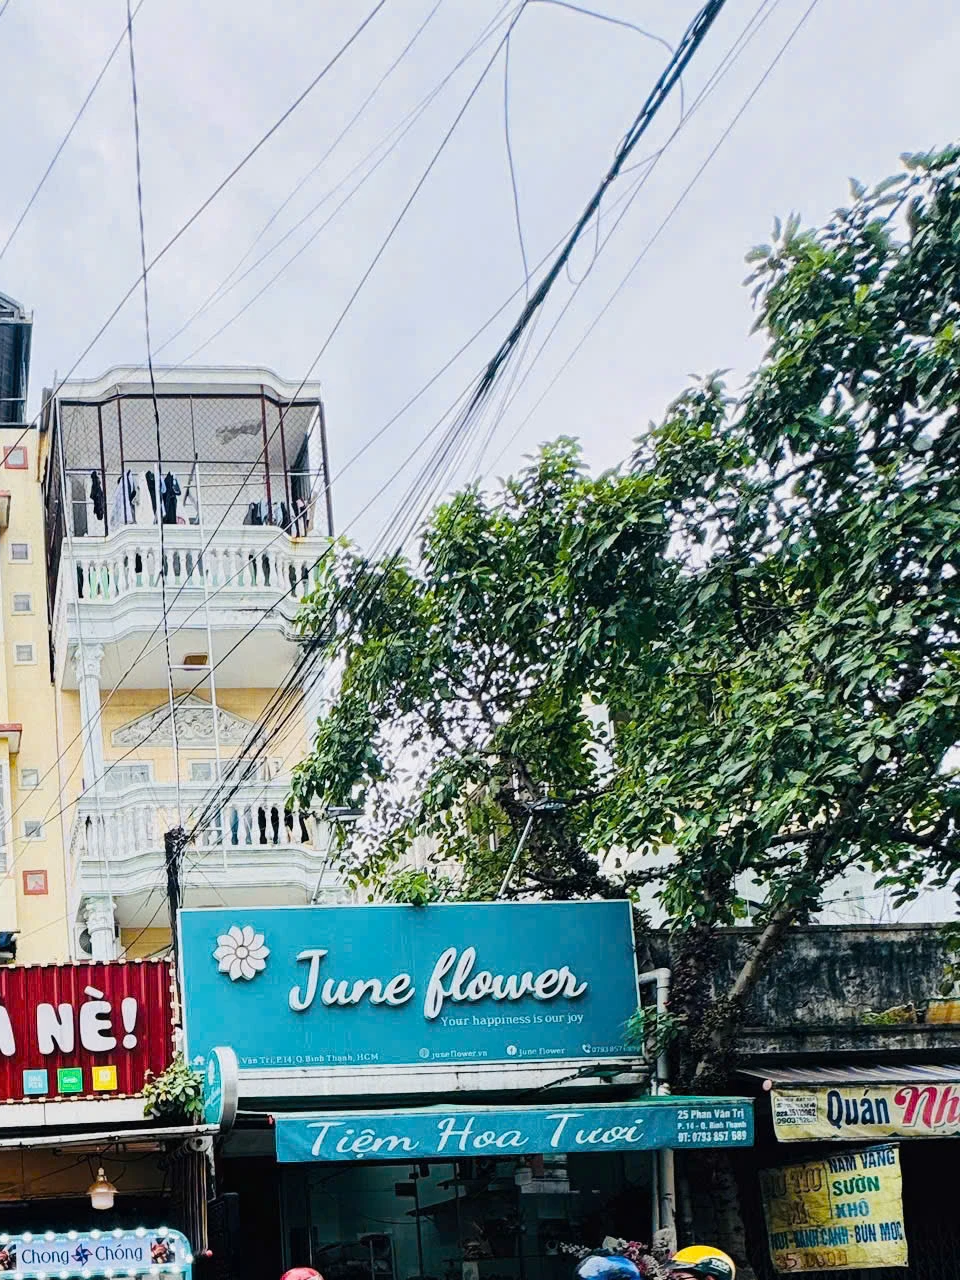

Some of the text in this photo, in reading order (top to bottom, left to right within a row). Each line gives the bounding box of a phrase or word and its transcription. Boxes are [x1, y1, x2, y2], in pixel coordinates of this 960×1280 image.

[288, 946, 587, 1020] June flower
[36, 985, 138, 1055] NÈ!
[441, 1013, 584, 1027] Your happiness is our joy
[356, 1053, 379, 1062] HCM
[677, 1110, 688, 1120] 25
[691, 1109, 712, 1119] Phan
[827, 1087, 890, 1130] Quán
[306, 1112, 644, 1160] Tiệm Hoa Tươi
[692, 1132, 711, 1142] 0793
[713, 1131, 728, 1141] 857
[827, 1154, 857, 1174] NAM
[832, 1174, 880, 1197] SƯỜN
[835, 1198, 870, 1219] KHÔ
[95, 1243, 143, 1262] Chóng
